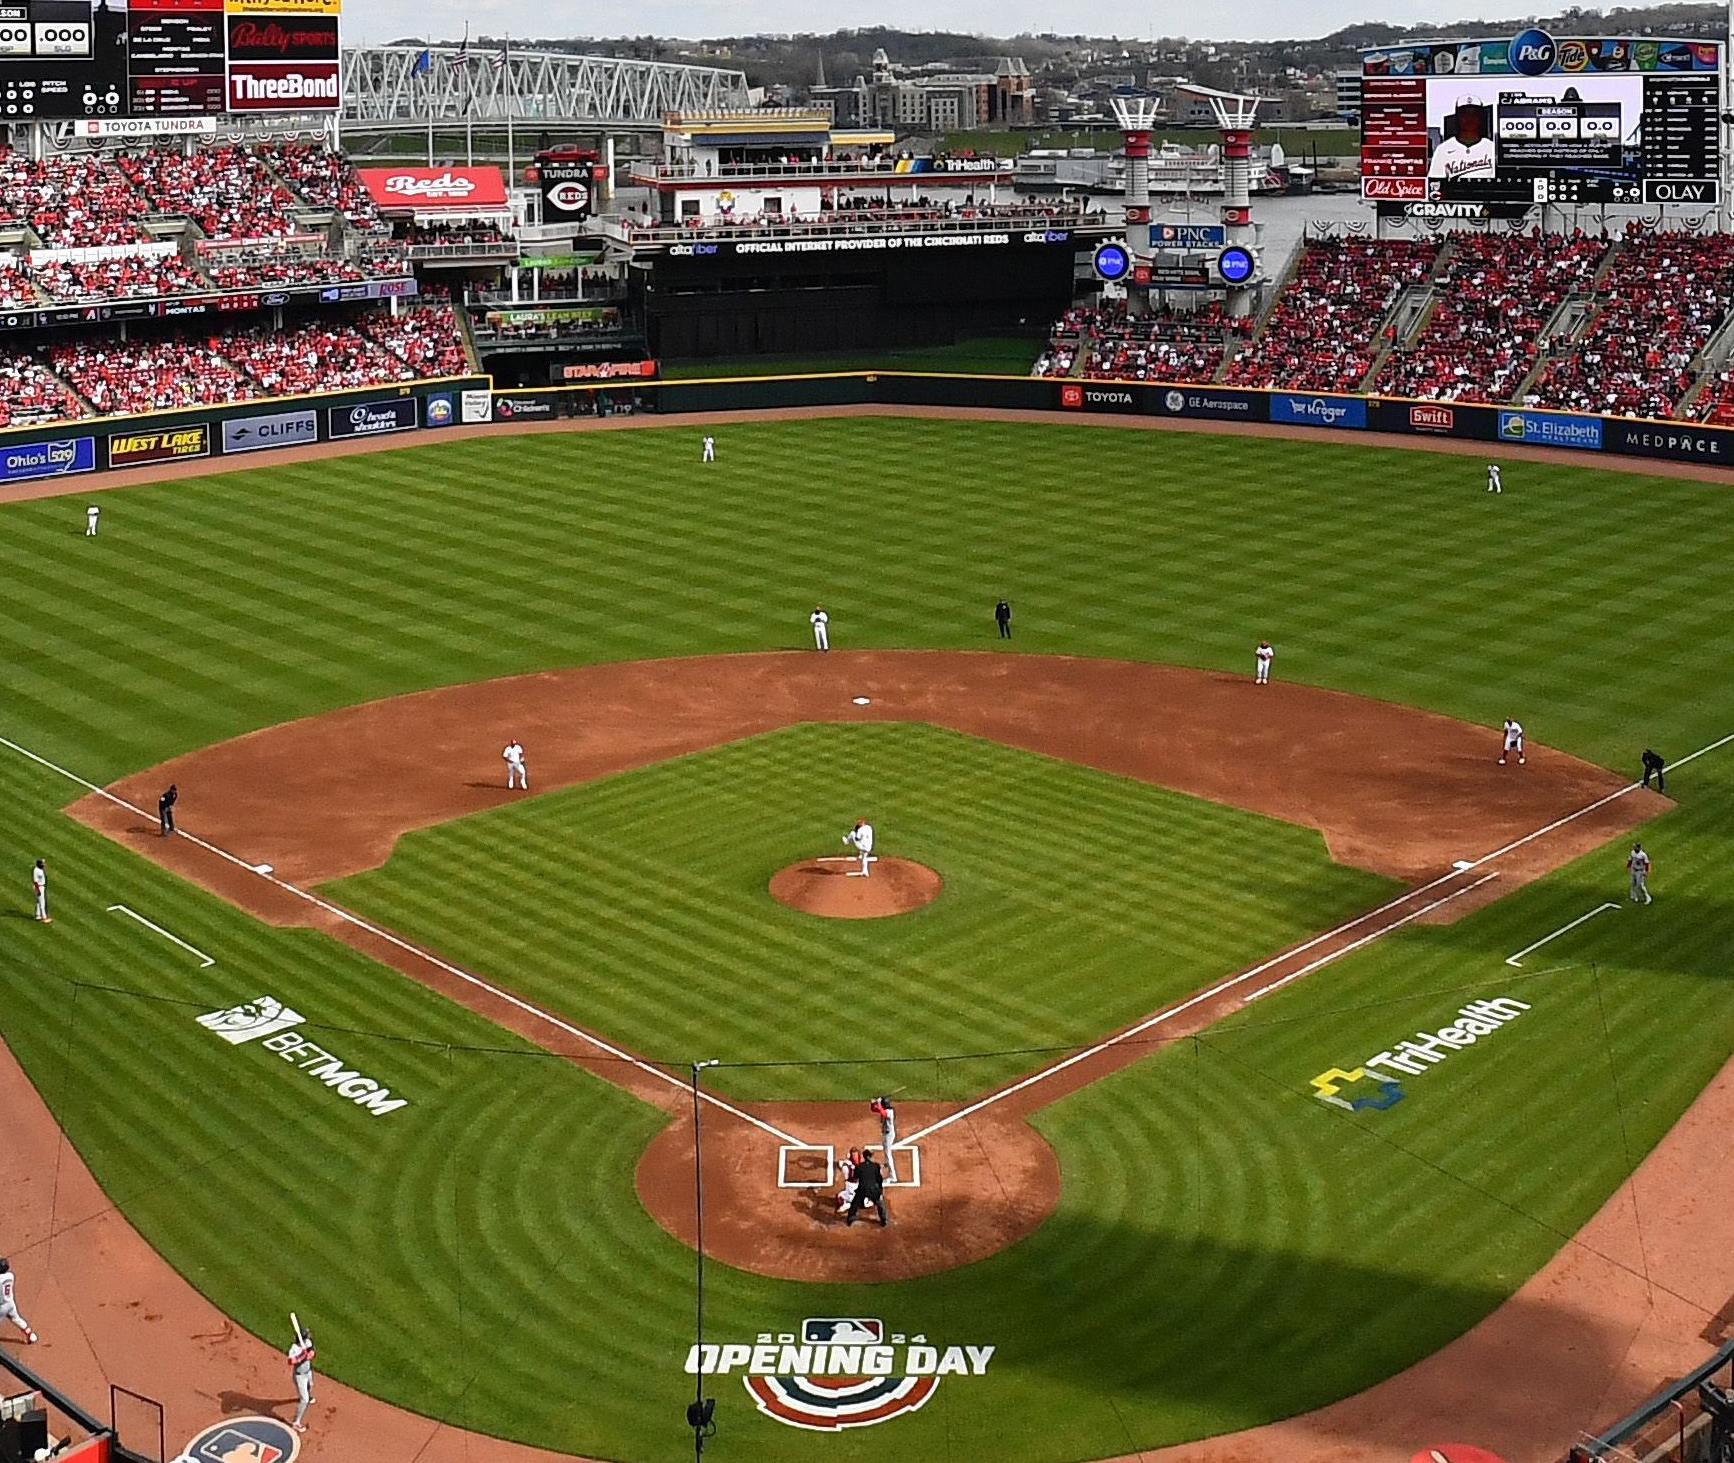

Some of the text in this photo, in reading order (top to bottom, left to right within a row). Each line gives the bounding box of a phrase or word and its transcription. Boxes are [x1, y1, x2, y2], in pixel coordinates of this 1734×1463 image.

[39, 28, 85, 42] .000
[1519, 44, 1551, 61] P&G
[1560, 49, 1586, 64] Tide
[231, 73, 337, 100] ThreeBond
[105, 120, 204, 133] TOYOTA TUNDRA
[945, 159, 994, 171] TriHealth
[543, 169, 589, 179] TUNDRA
[1366, 179, 1423, 197] Old Spice
[1656, 185, 1706, 199] OLAY
[559, 191, 589, 201] REDS
[1412, 203, 1483, 216] GRAVITY
[1177, 227, 1210, 240] PNC
[736, 235, 1009, 253] OFFICIAL INTERNET PROVIDER OF THE CINCINNATI REDS
[166, 306, 206, 315] MONTAS
[1086, 392, 1132, 404] TOYOTA
[1188, 397, 1249, 411] GE Aerospace
[1307, 399, 1347, 423] Kroger
[1413, 410, 1448, 425] Swift
[258, 419, 315, 438] CLIFFS
[1526, 419, 1599, 438] St. Elizabeth
[112, 429, 203, 454] WEST LAKE
[1626, 433, 1719, 453] MEDPACE
[7, 445, 73, 469] Ohio's 529
[172, 446, 200, 455] TIRES
[1366, 996, 1531, 1075] TriHealth
[262, 1031, 408, 1116] BETMGM
[757, 1333, 927, 1343] 20 24
[684, 1344, 995, 1374] OPENING DAY
